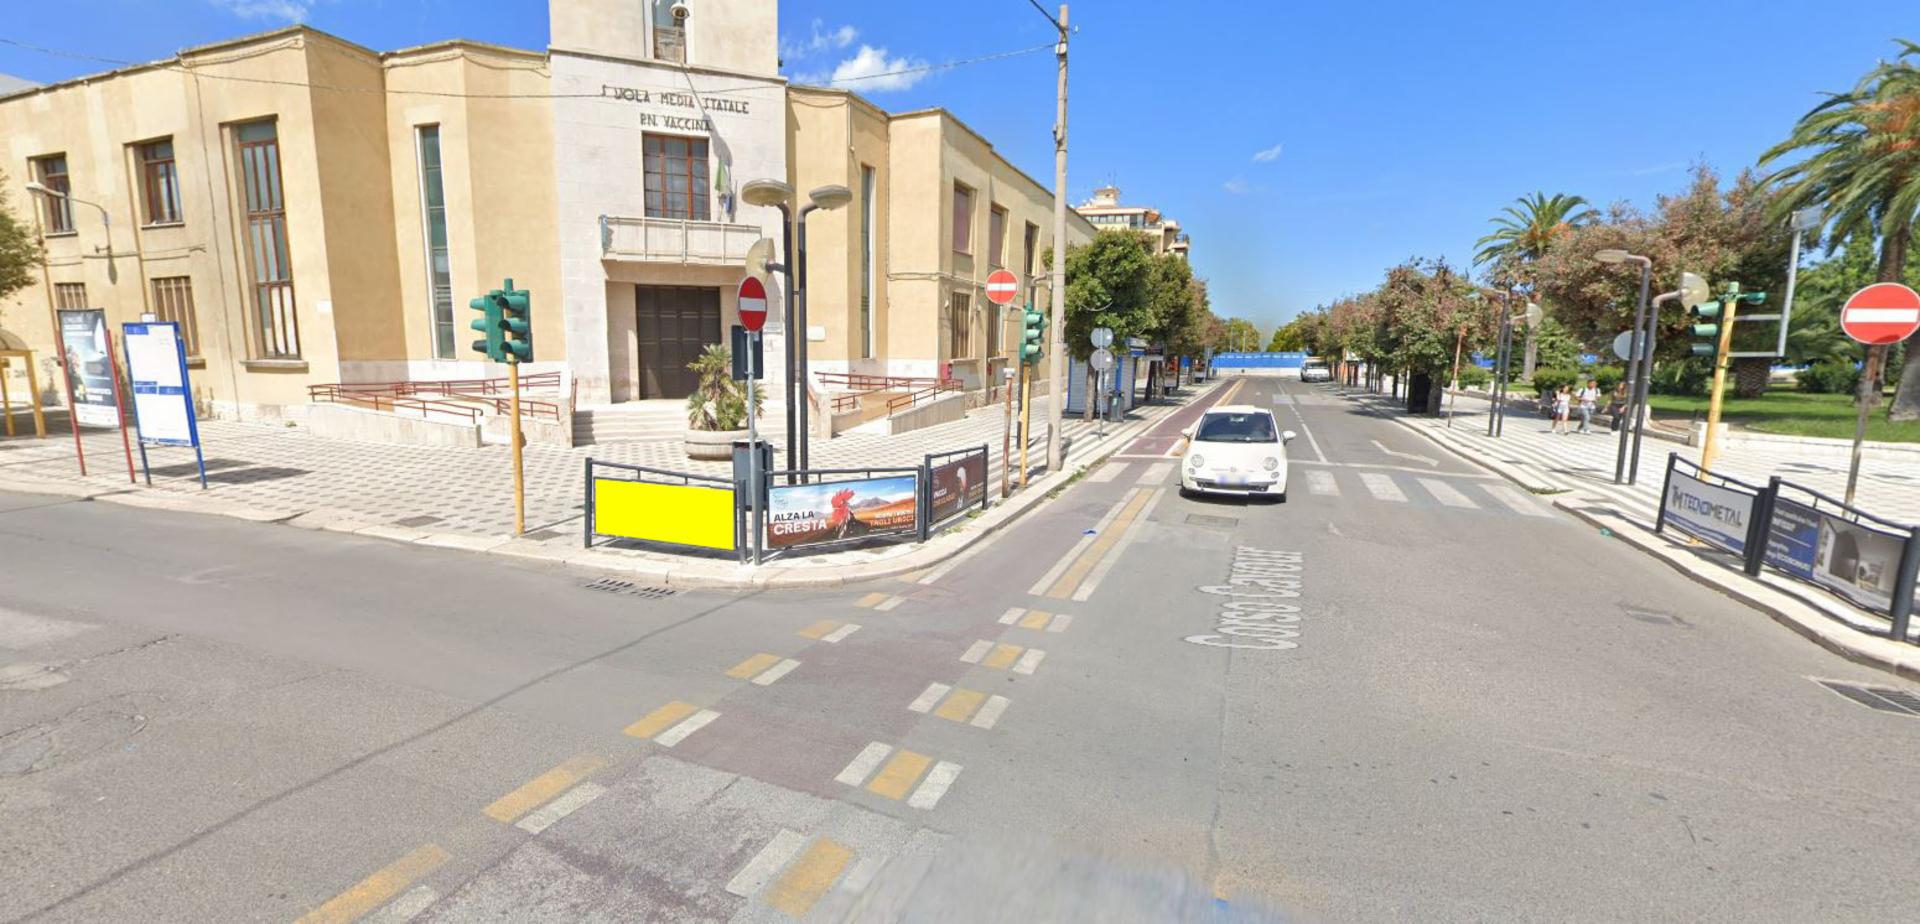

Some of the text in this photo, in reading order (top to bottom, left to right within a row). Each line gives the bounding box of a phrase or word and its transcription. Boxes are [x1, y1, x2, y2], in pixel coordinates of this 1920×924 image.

[660, 92, 695, 109] MEDIA
[702, 97, 750, 114] STATALE
[663, 115, 713, 132] VACCINA
[774, 510, 815, 522] ALZA LA
[773, 519, 827, 536] CRESTA
